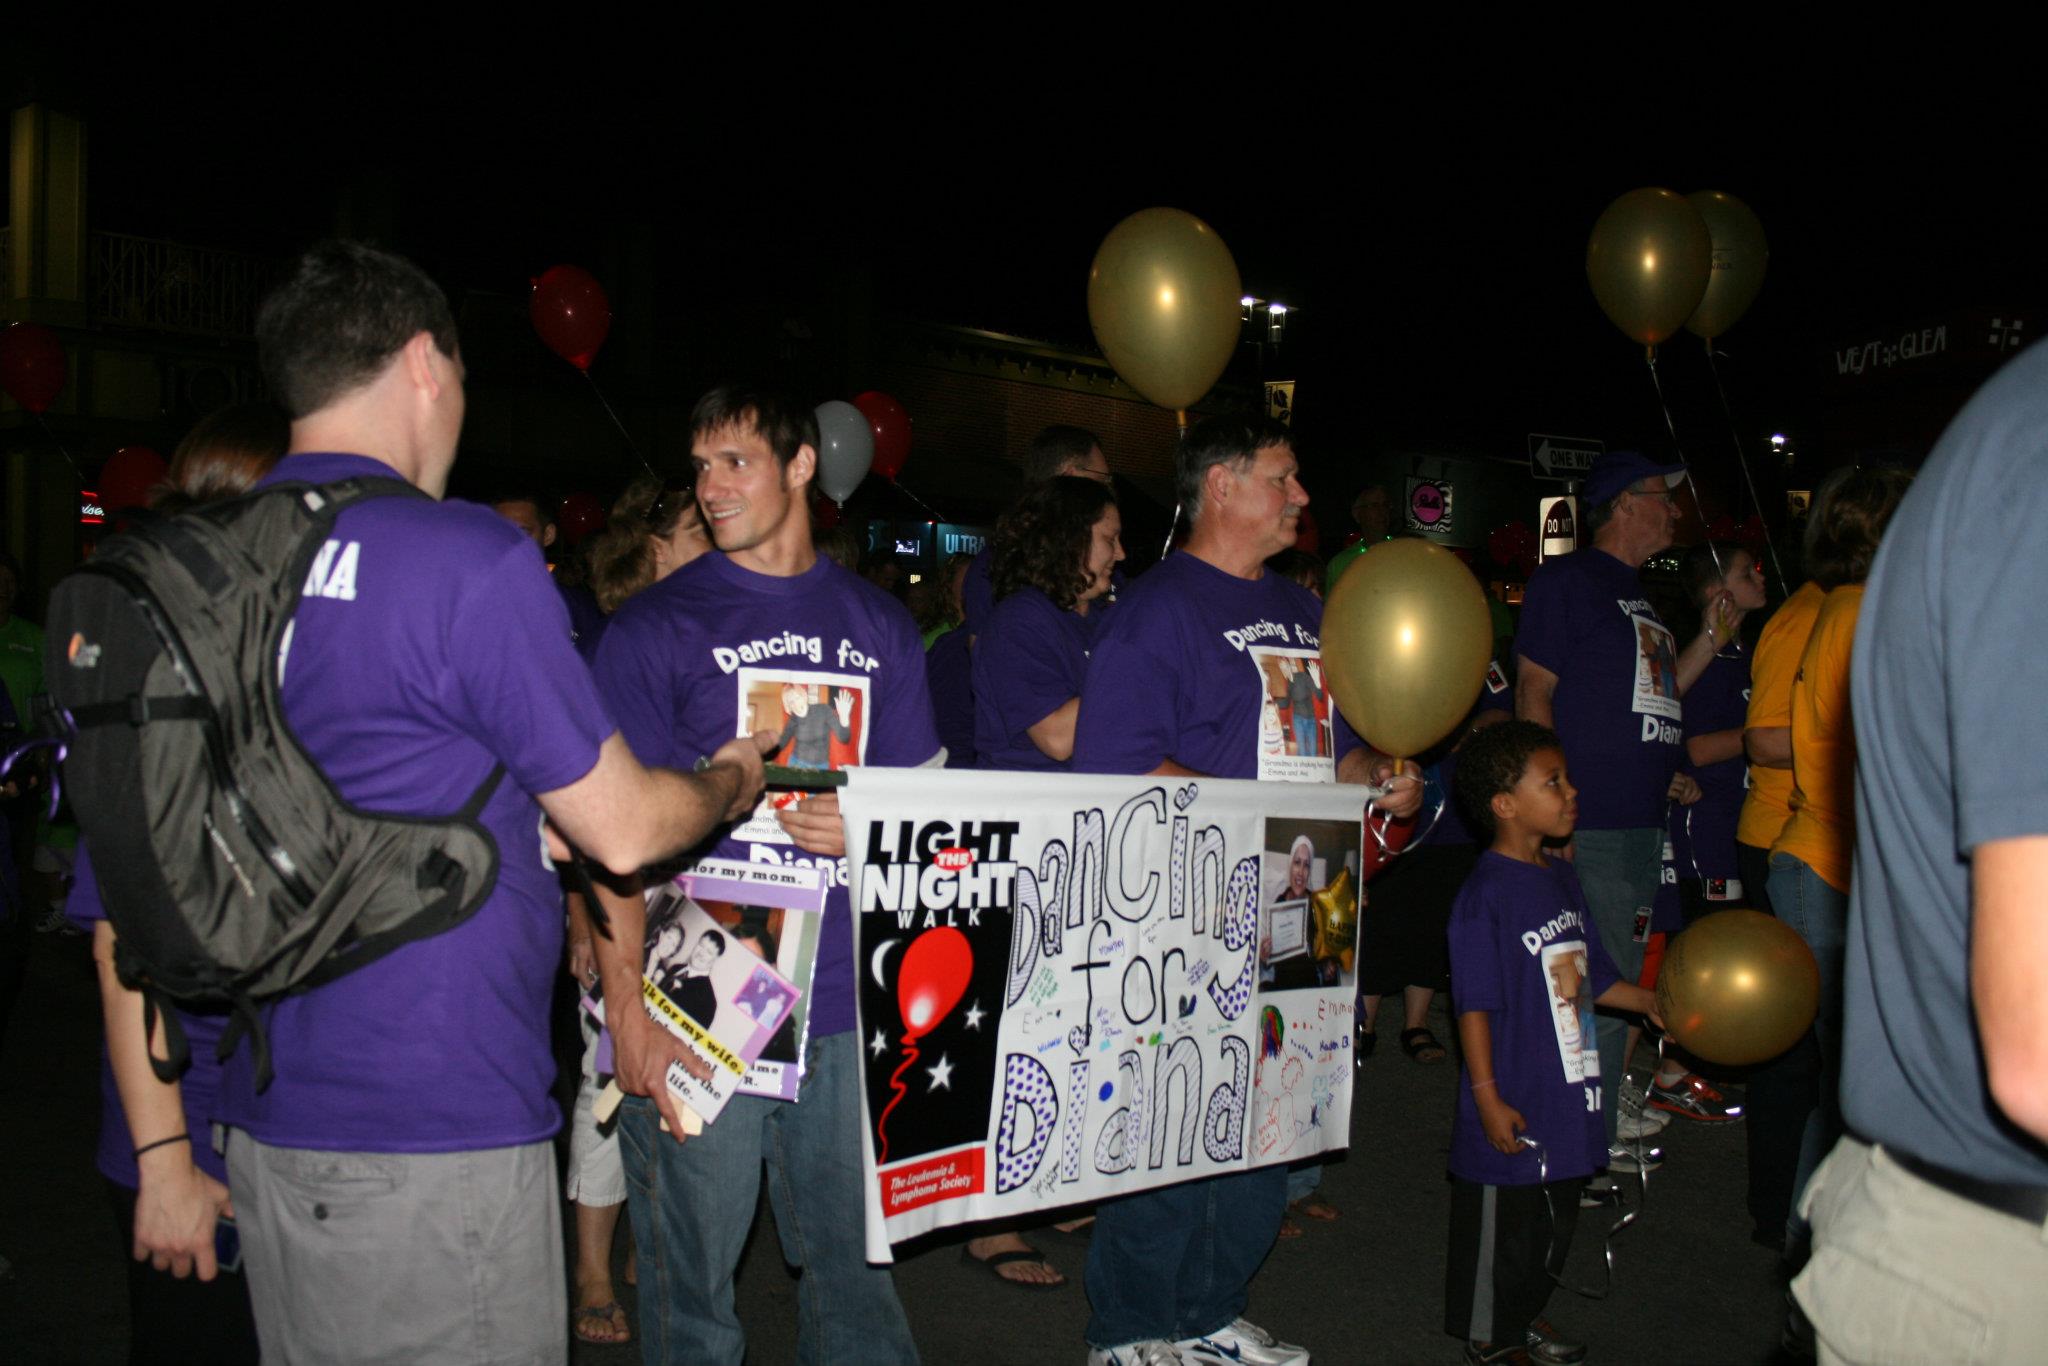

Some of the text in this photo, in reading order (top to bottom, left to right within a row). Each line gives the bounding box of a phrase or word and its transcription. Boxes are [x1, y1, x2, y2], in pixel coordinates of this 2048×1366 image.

[1549, 449, 1573, 467] ONE
[1547, 518, 1558, 533] DO
[945, 533, 986, 555] ULTRA
[1617, 598, 1656, 617] Danci
[1223, 619, 1320, 651] Dancing for
[712, 631, 879, 675] Dancing for
[866, 820, 1020, 863] LIGHT
[937, 852, 970, 867] THE
[721, 867, 746, 880] my
[752, 870, 802, 884] mom.
[860, 862, 1018, 912] NIGHT
[897, 907, 981, 929] WALK
[1071, 919, 1187, 1047] for
[657, 997, 679, 1020] for
[680, 1019, 704, 1041] my
[707, 1040, 742, 1075] wife.
[667, 1073, 693, 1100] life.
[996, 1024, 1250, 1195] Diana
[890, 1162, 956, 1191] The Leukemia &
[890, 1176, 972, 1206] Lymphoma Society
